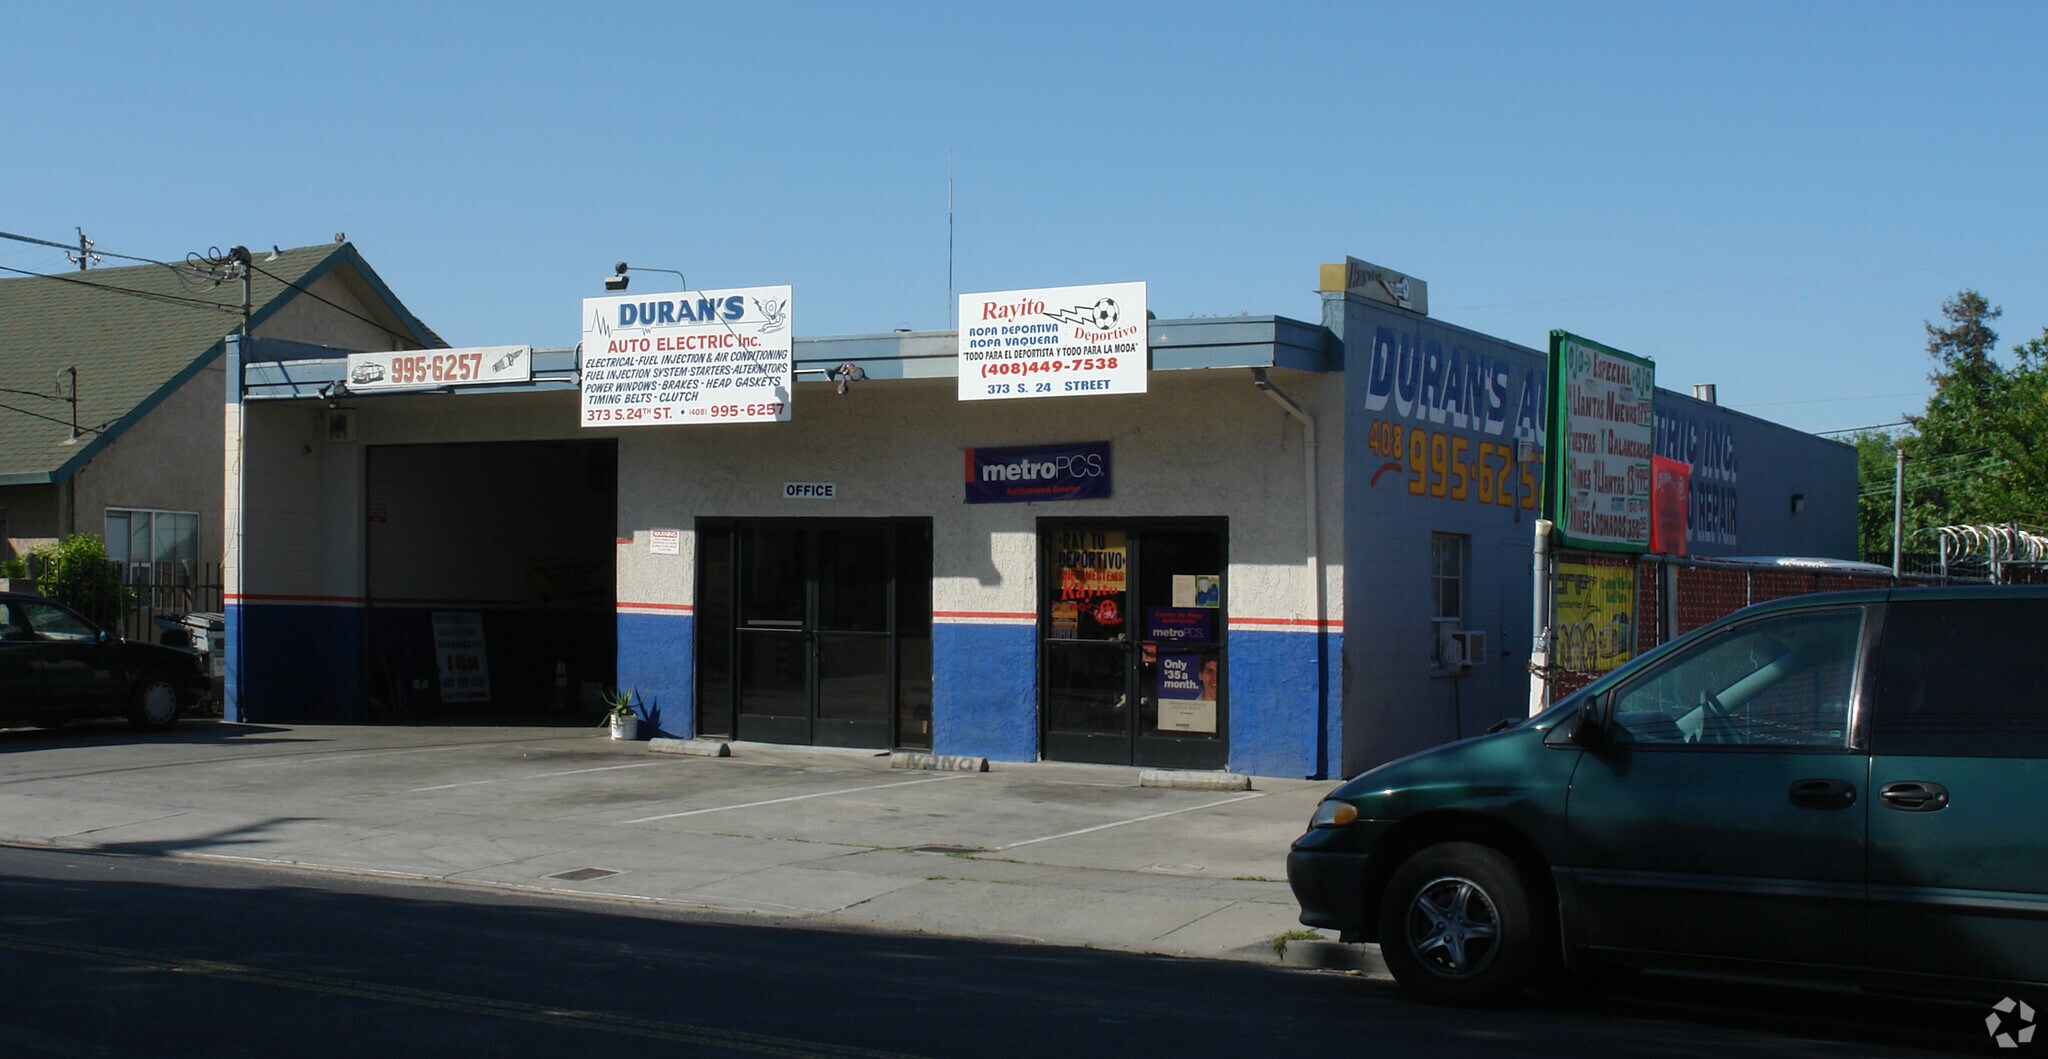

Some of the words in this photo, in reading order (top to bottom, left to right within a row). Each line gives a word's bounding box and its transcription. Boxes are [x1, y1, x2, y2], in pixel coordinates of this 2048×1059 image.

[618, 295, 745, 327] DURAN'S
[982, 297, 1045, 323] Rayito
[969, 326, 998, 337] ROPA
[1001, 323, 1059, 335] DEPORTIVA
[1073, 325, 1137, 344] Deportivo
[607, 338, 651, 353] AUTO
[656, 334, 734, 351] ELECTRIC
[738, 333, 762, 348] Inc.
[970, 338, 1000, 348] ROPA
[1005, 335, 1059, 348] VAQUERA
[661, 352, 706, 365] INJECTION
[706, 353, 713, 363] &
[713, 352, 729, 363] AIR
[730, 350, 788, 362] CONDITIONING
[985, 351, 1003, 360] PARA
[1004, 350, 1012, 359] EL
[1014, 348, 1054, 359] DEPORTISTA
[1056, 348, 1061, 357] Y
[1062, 347, 1082, 357] TODO
[1083, 345, 1102, 355] PARA
[1103, 345, 1113, 354] LA
[391, 353, 483, 384] 995-6257
[585, 370, 605, 381] FUEL
[606, 368, 651, 380] INJECTION
[584, 382, 614, 394] POWER
[706, 378, 732, 389] HEAD
[735, 376, 782, 387] GASKETS
[987, 384, 1010, 395] 373
[1017, 383, 1028, 393] S.
[1035, 382, 1051, 393] 24
[1064, 380, 1111, 391] STREET
[1365, 326, 1510, 435] DURAN'S
[588, 395, 622, 405] TIMING
[624, 393, 653, 404] BELTS
[659, 391, 699, 403] CLUTCH
[587, 409, 611, 421] 373
[653, 407, 673, 419] ST.
[710, 403, 785, 417] 995-6257
[1368, 419, 1404, 460] 408
[982, 454, 1102, 481] metroPCS
[786, 484, 833, 496] OFFICE
[1061, 574, 1118, 603] Rayito
[1164, 659, 1187, 671] Only
[1164, 670, 1181, 679] $35
[1182, 672, 1188, 680] a
[1164, 680, 1199, 689] month.
